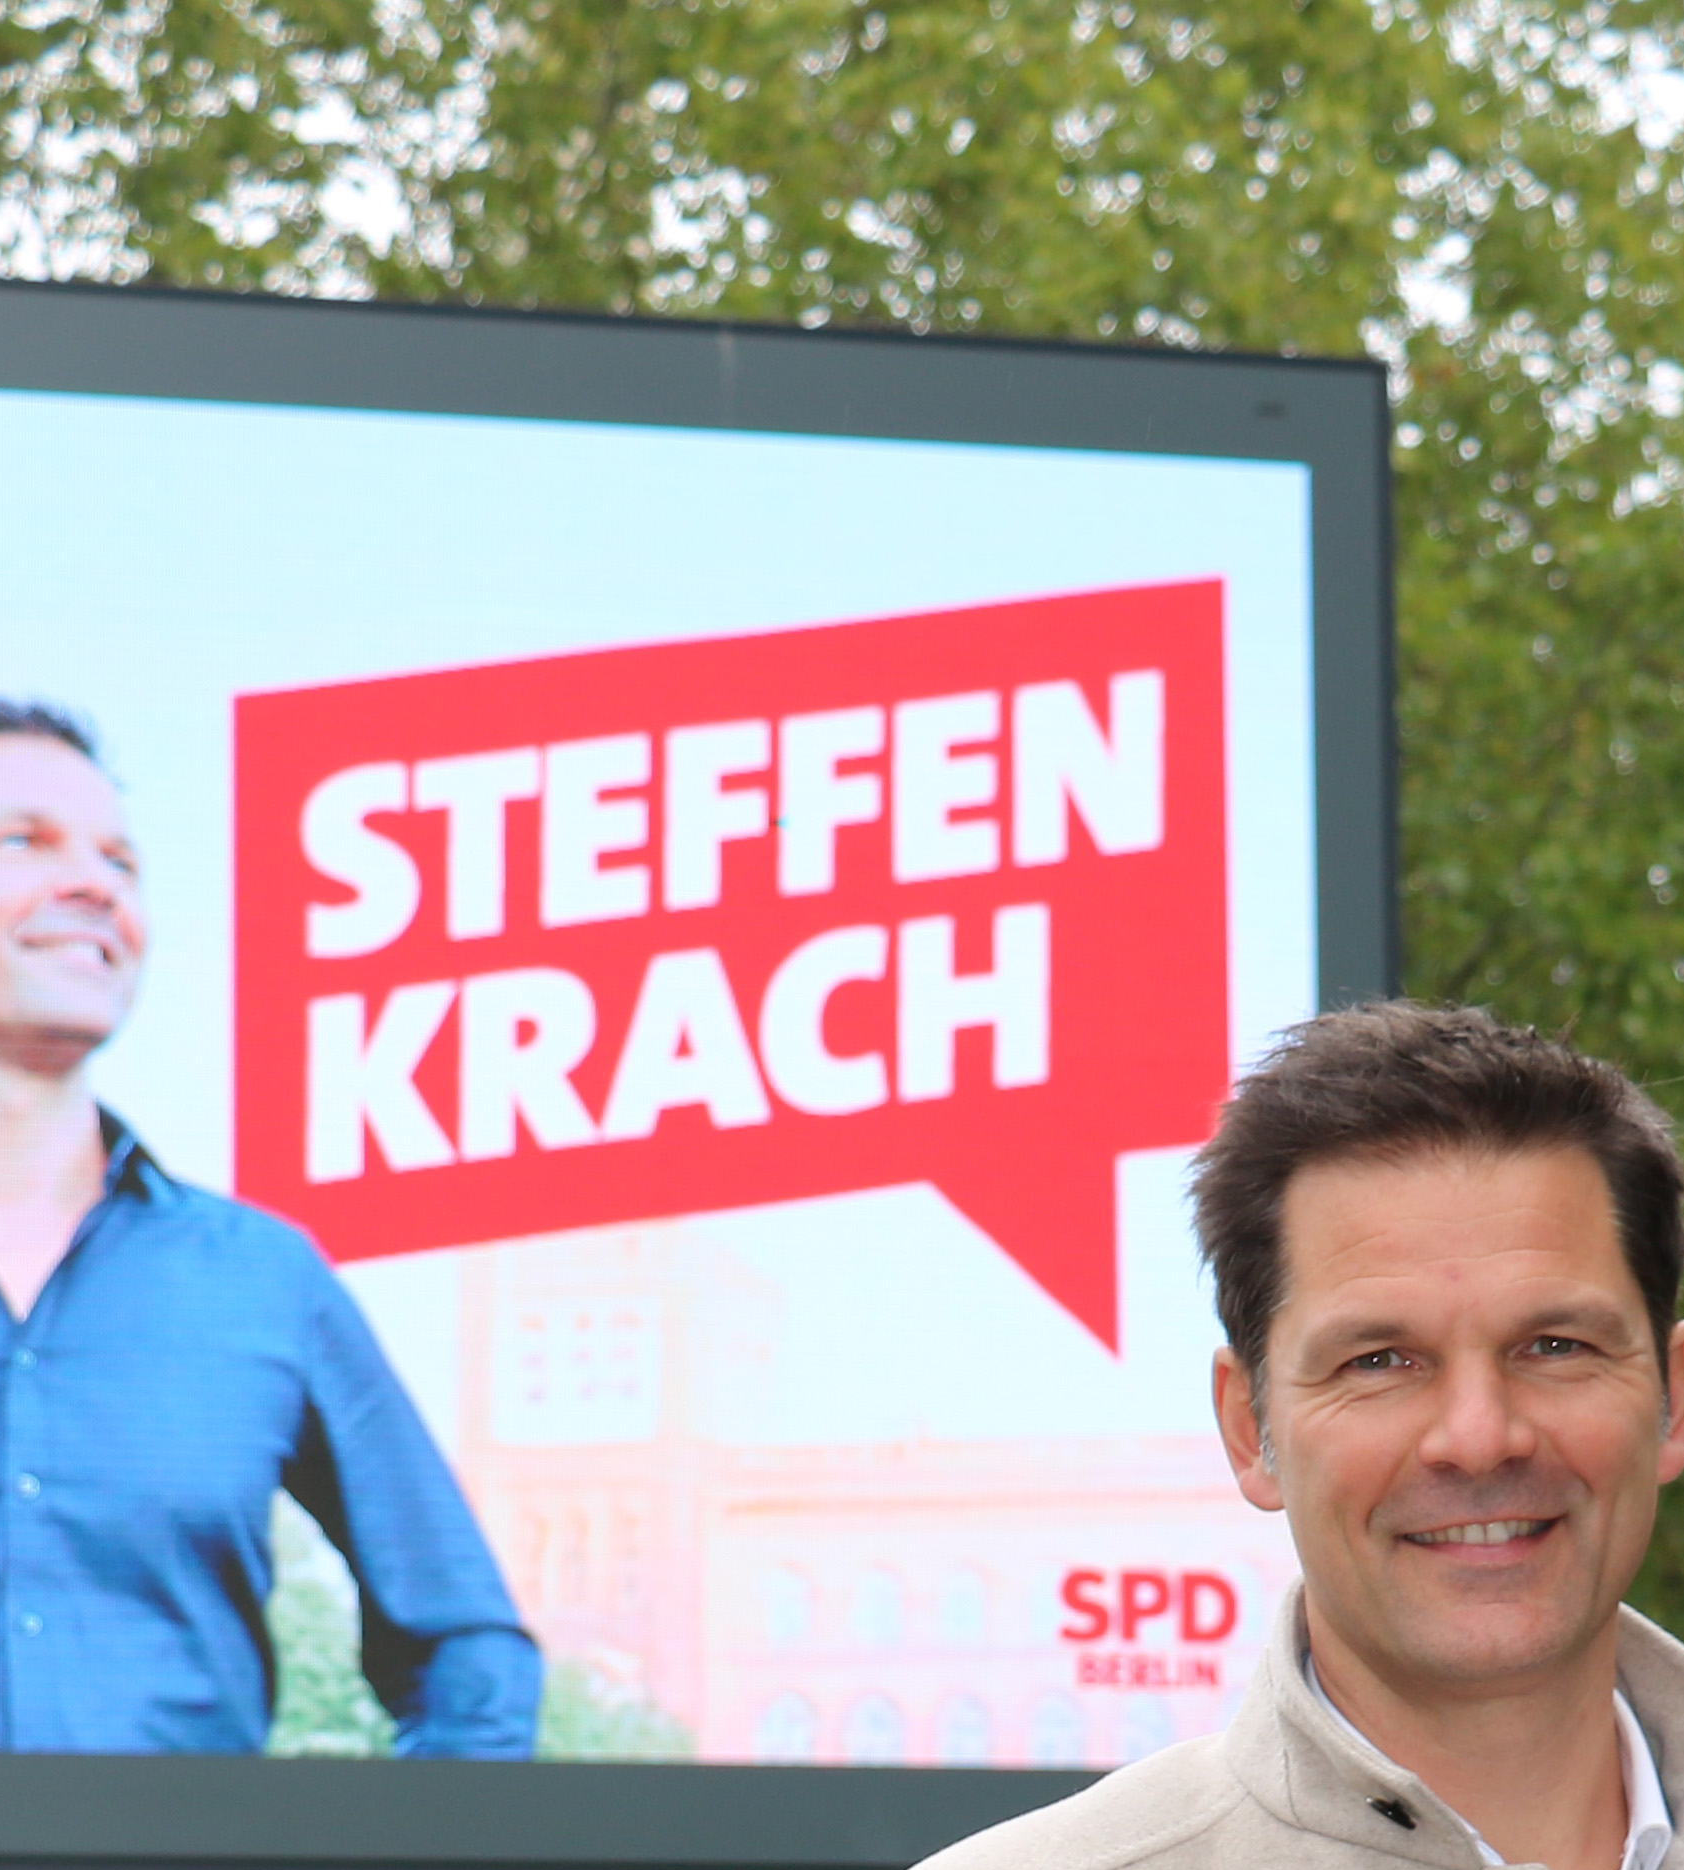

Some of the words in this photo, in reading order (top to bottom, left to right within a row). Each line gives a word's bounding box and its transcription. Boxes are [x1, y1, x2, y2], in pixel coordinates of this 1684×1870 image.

[298, 668, 1165, 960] STEFFEN
[304, 901, 1052, 1187] KRACH
[1059, 1569, 1239, 1643] SPD
[1076, 1652, 1223, 1689] BERLIN
